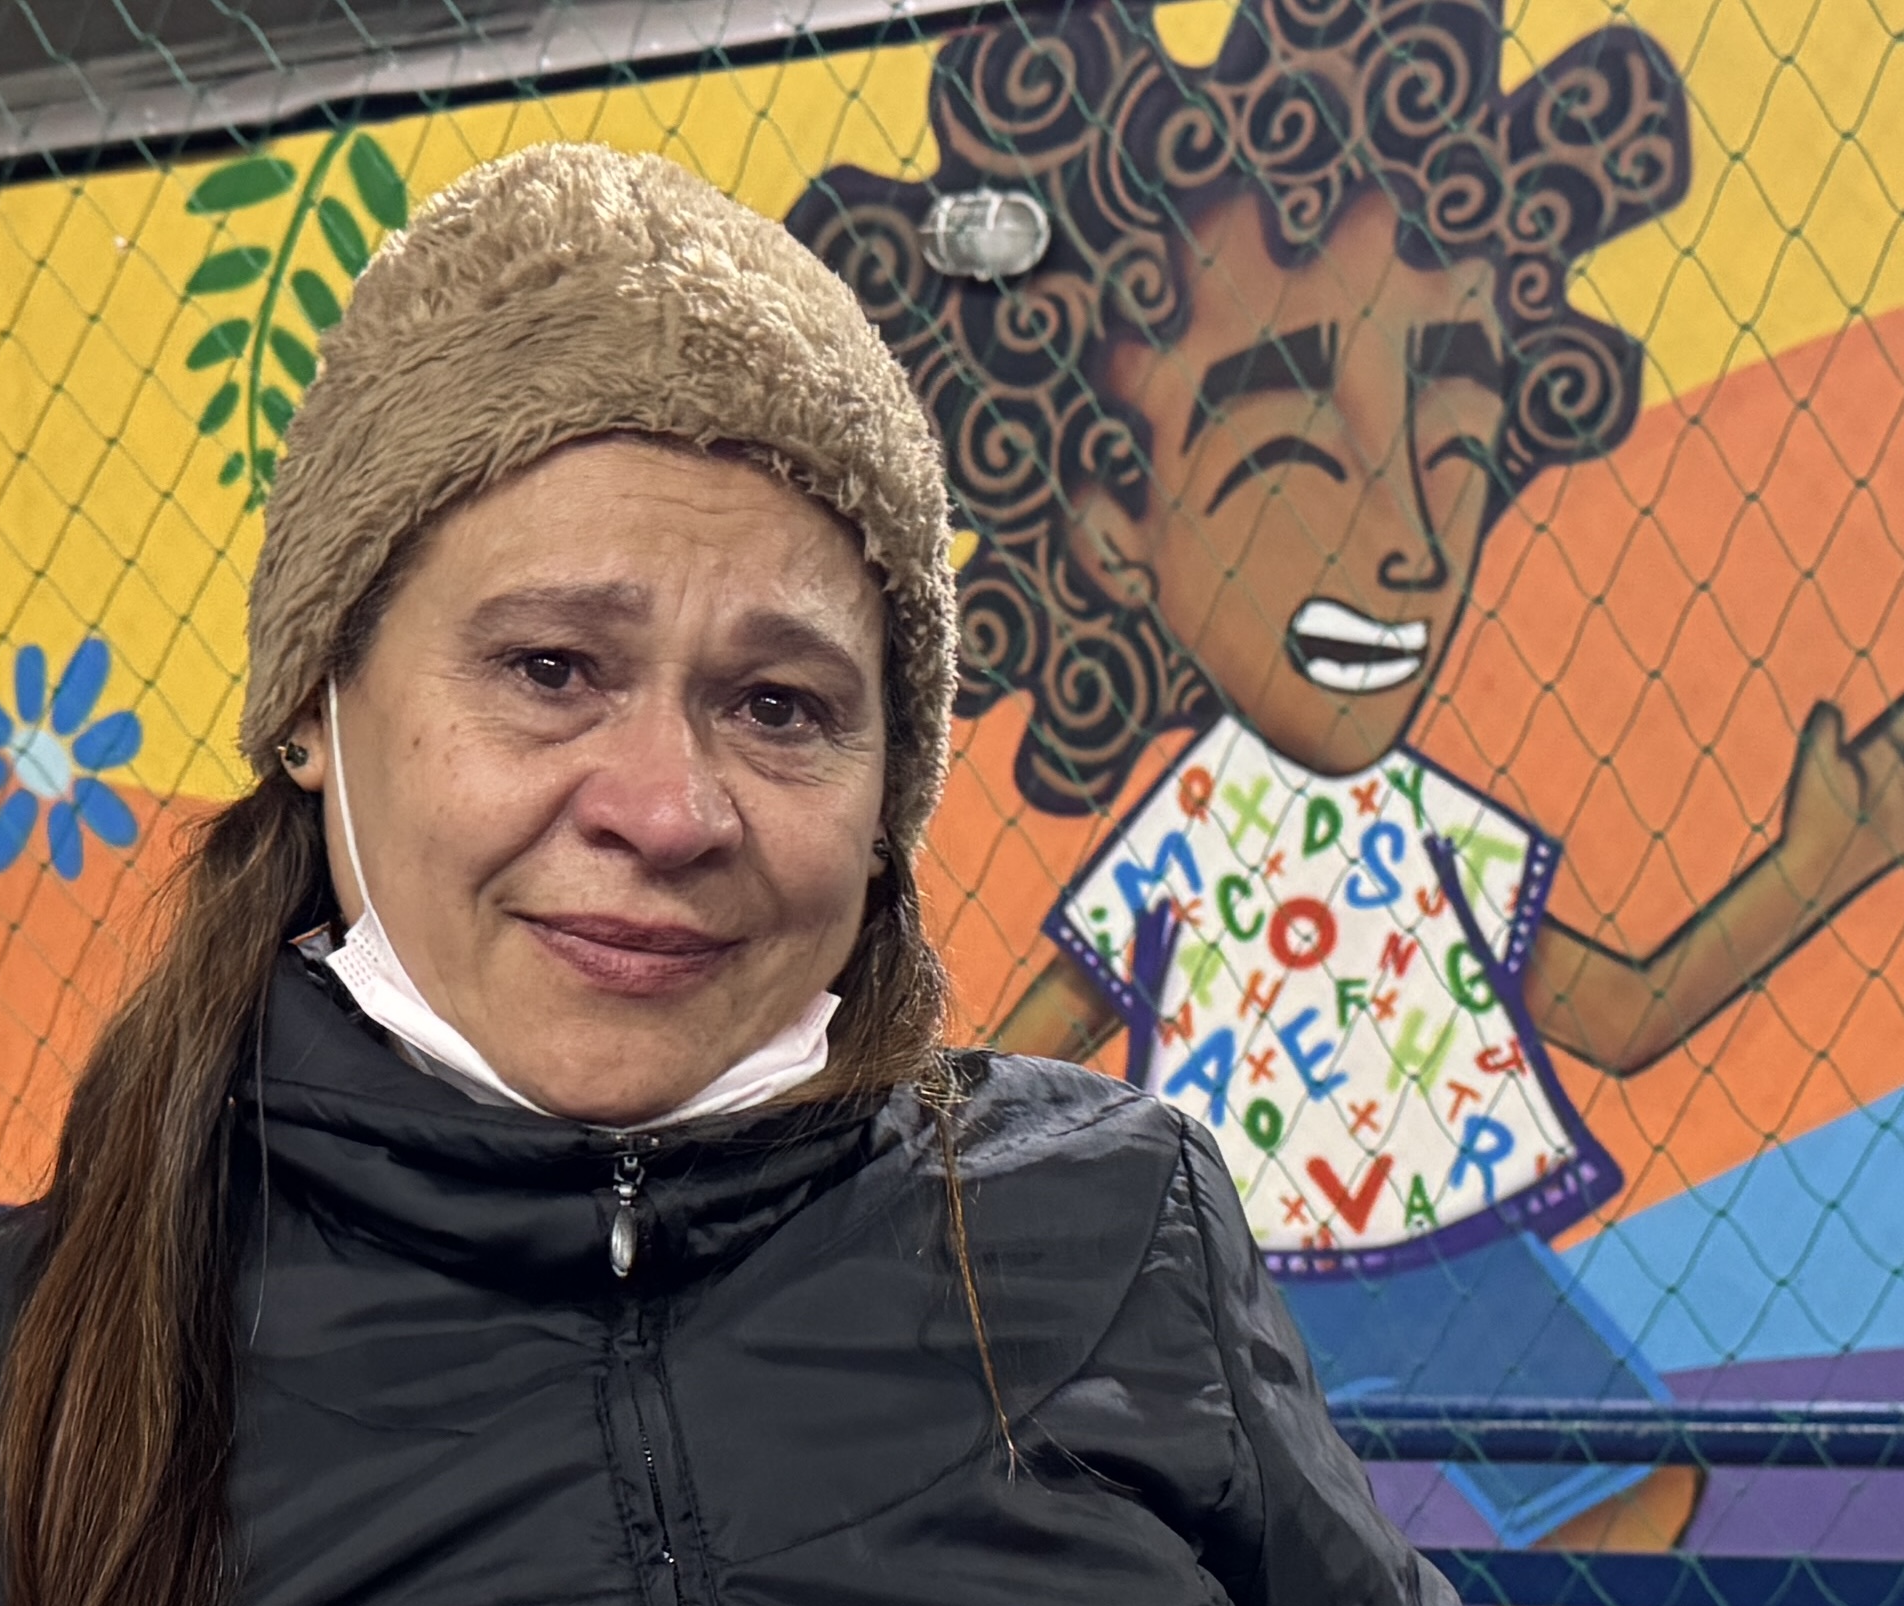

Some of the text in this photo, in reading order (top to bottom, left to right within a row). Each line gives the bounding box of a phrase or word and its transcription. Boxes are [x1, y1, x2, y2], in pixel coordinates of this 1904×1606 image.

[1302, 796, 1343, 857] D
[1344, 821, 1405, 909] S
[1216, 874, 1265, 942] C
[1306, 1154, 1394, 1234] V
